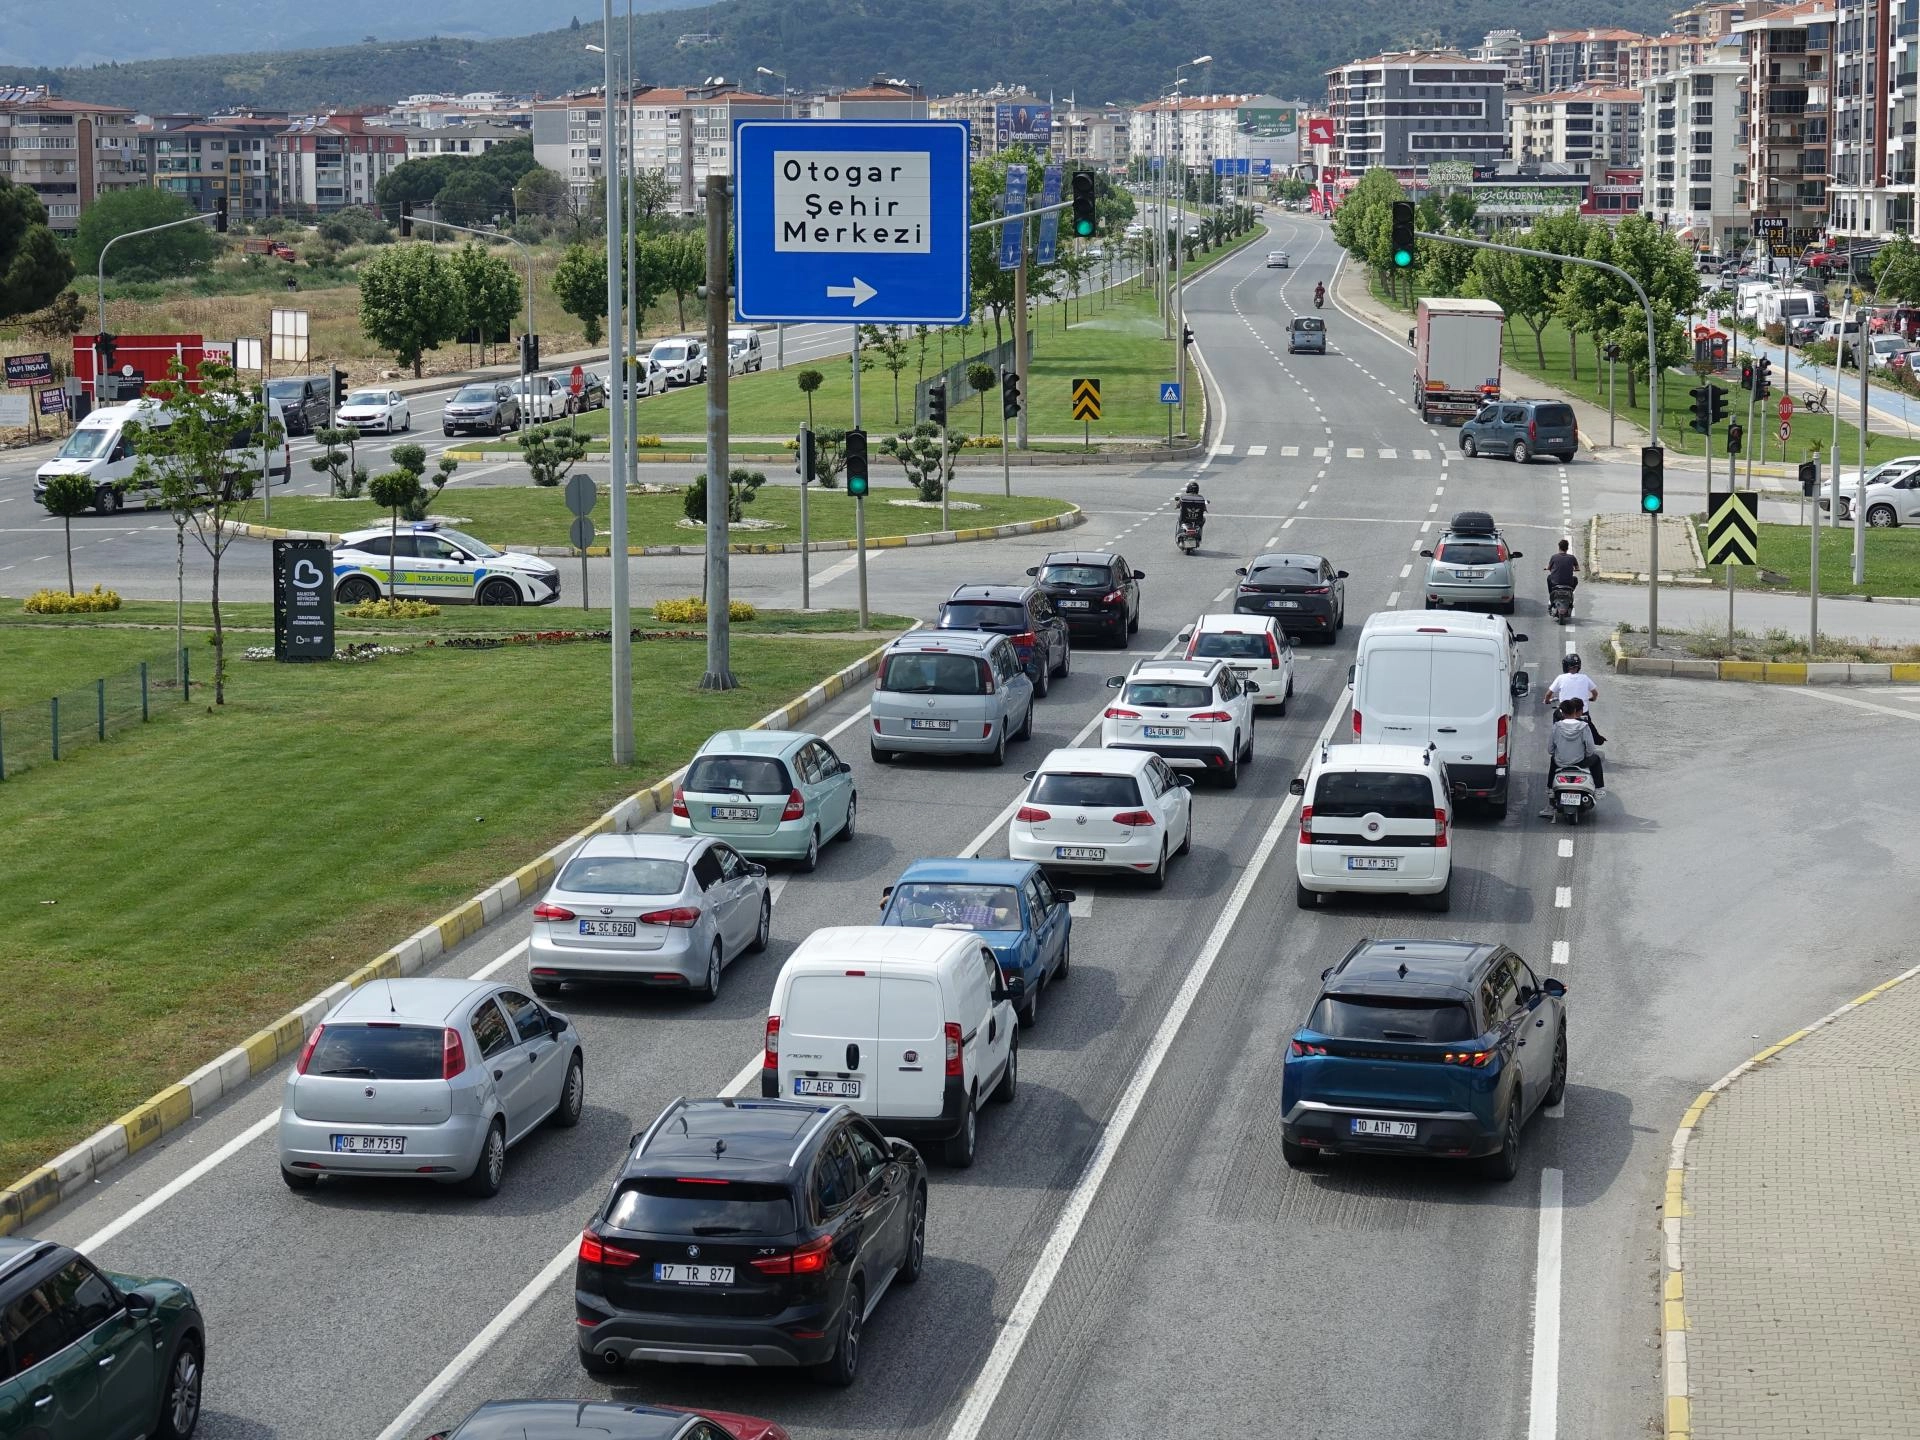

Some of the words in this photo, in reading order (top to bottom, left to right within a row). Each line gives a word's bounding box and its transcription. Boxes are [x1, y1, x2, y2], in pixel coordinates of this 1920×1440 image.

[783, 159, 901, 187] Otogar
[805, 193, 899, 219] Şehir
[783, 221, 921, 244] Merkezi
[571, 375, 583, 385] DUR
[1779, 404, 1792, 414] DUR
[1355, 858, 1363, 867] 10
[1381, 859, 1395, 868] 315
[585, 922, 595, 932] 34
[599, 922, 609, 932] SC
[612, 923, 633, 933] 6260
[802, 1081, 811, 1092] 17
[816, 1081, 834, 1093] AER
[841, 1082, 857, 1094] 019
[1358, 1120, 1367, 1131] 10
[1374, 1122, 1391, 1133] ATH
[1399, 1123, 1416, 1135] 707
[343, 1136, 355, 1148] 06
[363, 1137, 375, 1149] BM
[378, 1137, 401, 1149] 7515
[663, 1265, 674, 1279] 17
[685, 1266, 699, 1280] TR
[710, 1267, 732, 1281] 877
